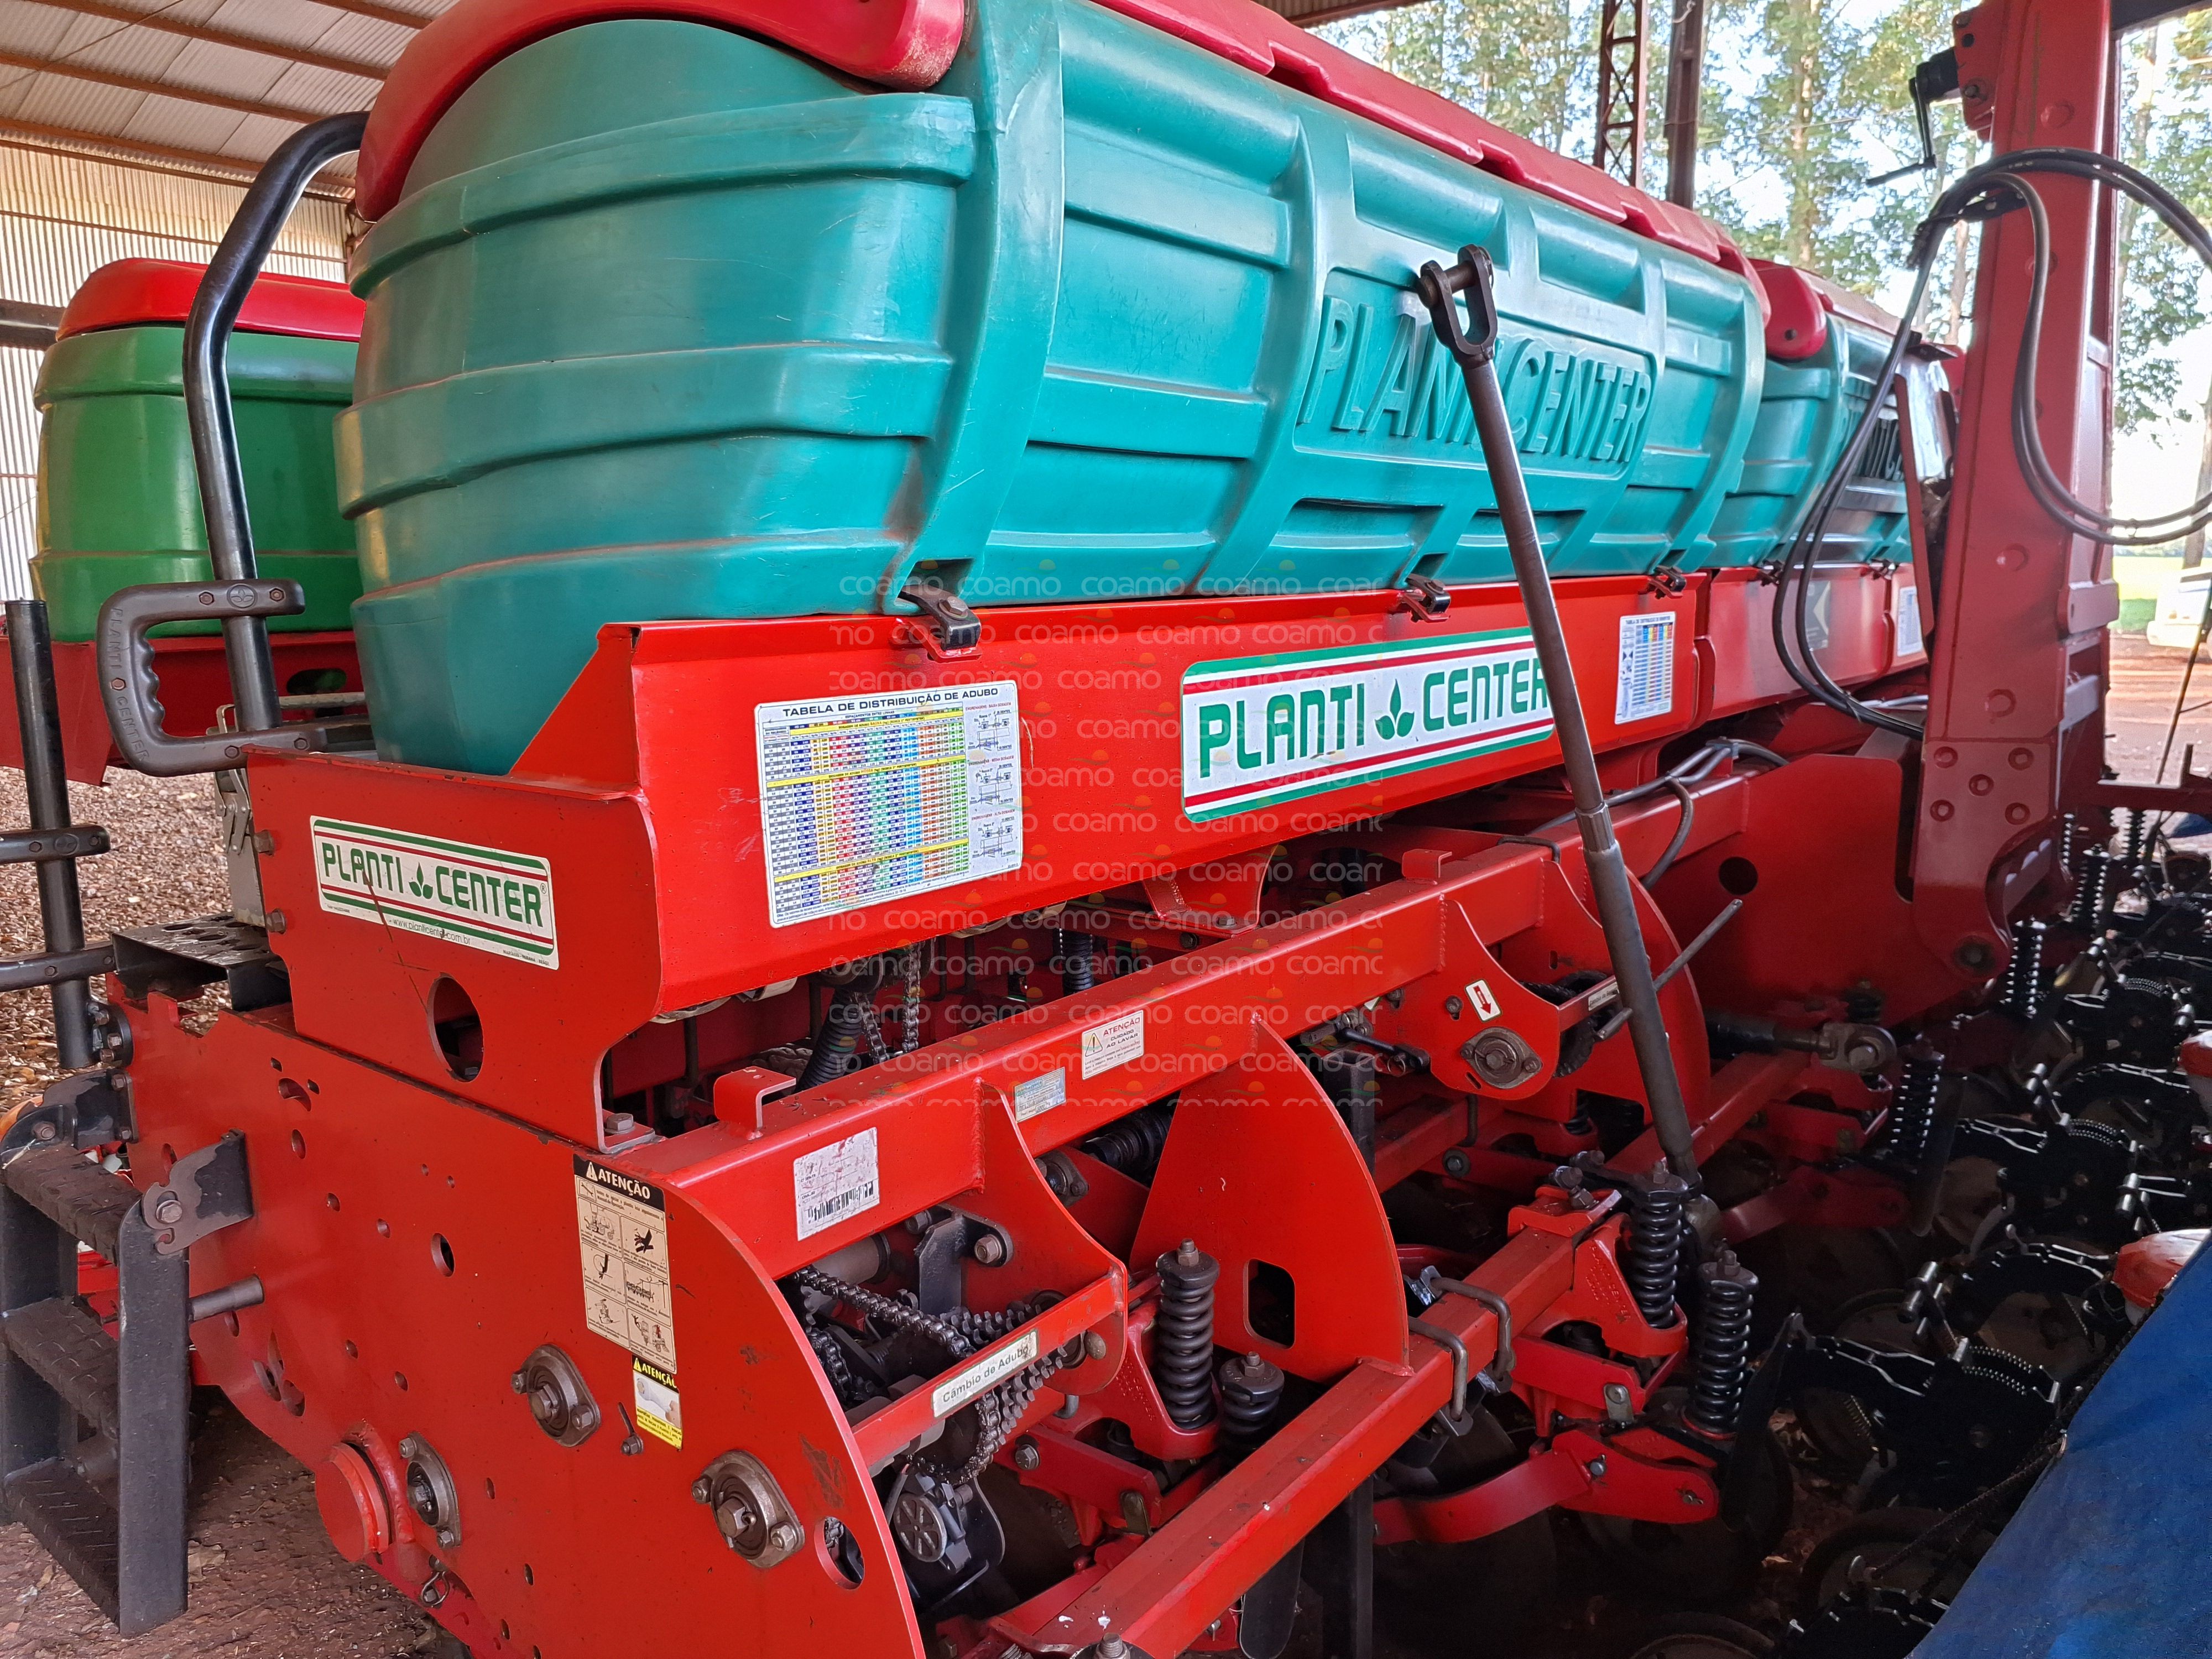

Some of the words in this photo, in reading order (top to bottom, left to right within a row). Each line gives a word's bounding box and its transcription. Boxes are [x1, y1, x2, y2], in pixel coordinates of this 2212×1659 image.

[1297, 296, 1504, 446] PLAN
[1503, 337, 1651, 462] CENTER
[110, 608, 123, 669] PLANTI
[782, 704, 833, 717] TABELA
[838, 702, 855, 712] DE
[859, 692, 941, 711] DISTRIBUIÇÃO
[944, 692, 958, 700] DE
[962, 688, 998, 698] ADUBO
[1198, 683, 1364, 778] PLANTI
[1423, 658, 1547, 732] CENTER
[115, 696, 150, 761] CENTER
[322, 842, 404, 894] PLANTI
[435, 865, 543, 927] CENTER
[393, 918, 471, 945] www.planticente.com.br
[1103, 1017, 1140, 1037] ATENÇÃO
[1110, 1029, 1134, 1041] CUIDADO
[1118, 1033, 1138, 1044] LAVAR
[598, 1168, 650, 1199] ATENÇÃO
[943, 1375, 980, 1403] Câmbio
[984, 1366, 995, 1378] de
[998, 1345, 1029, 1369] Adubo
